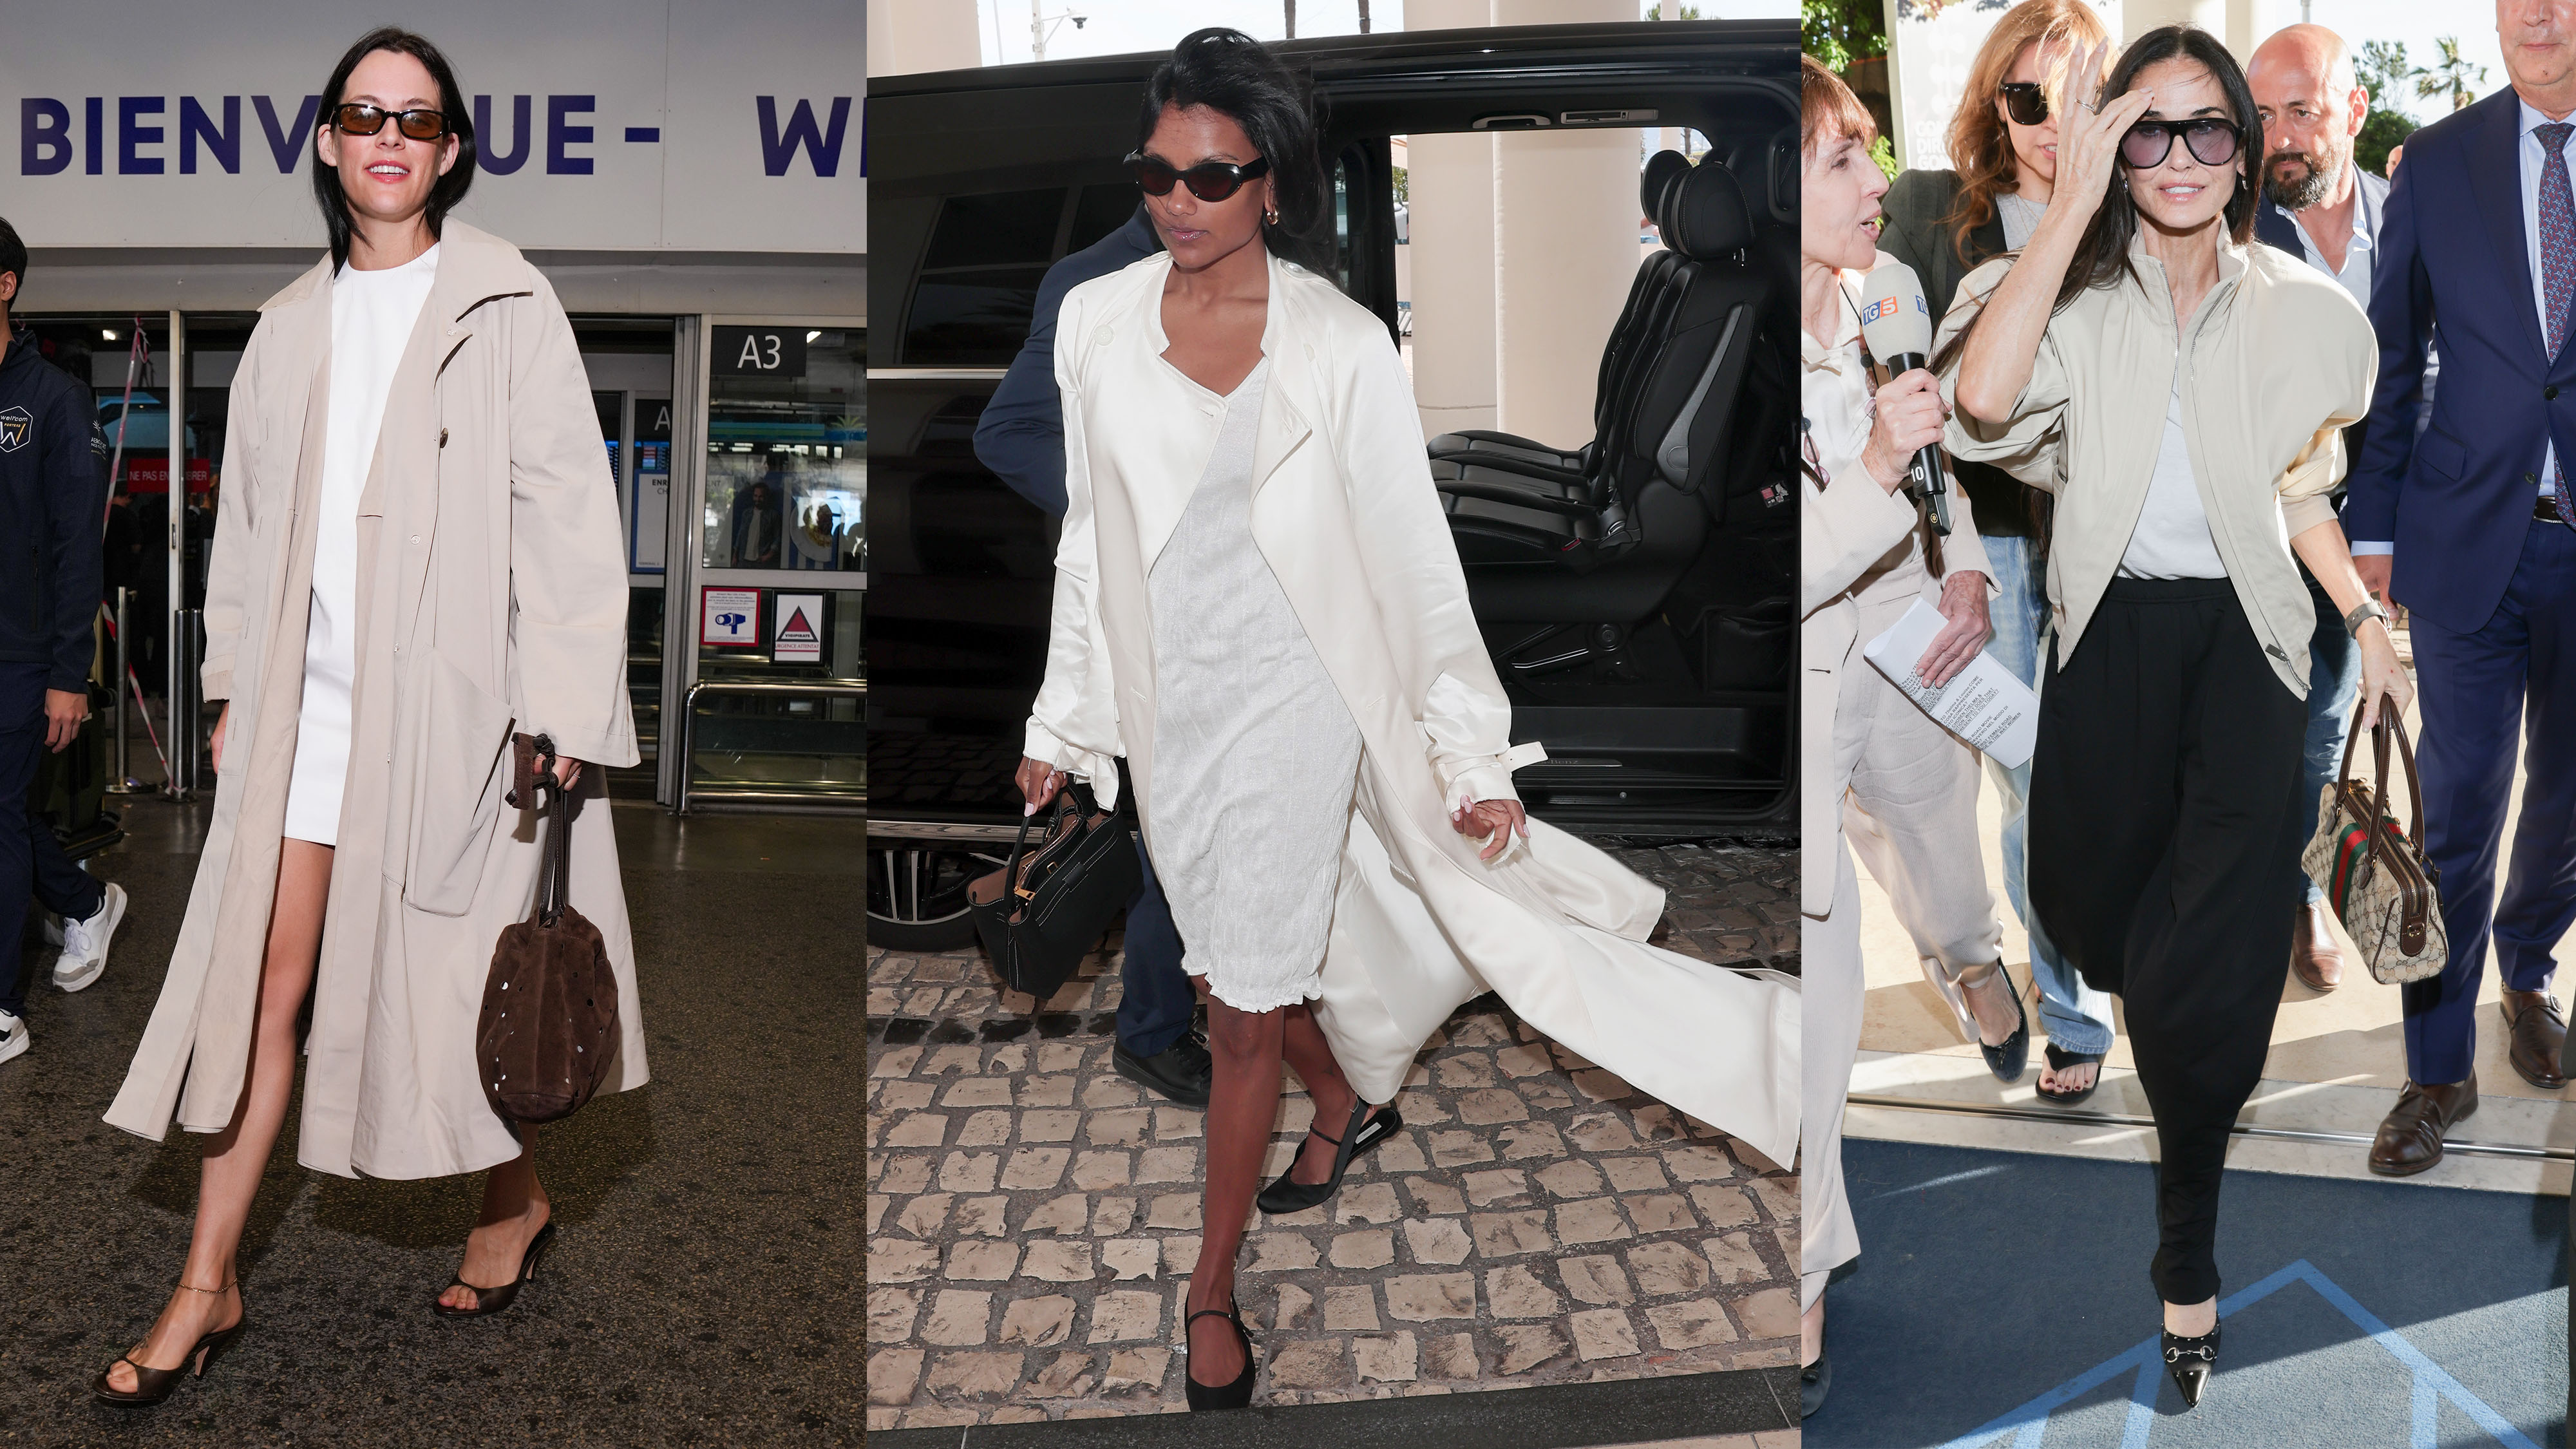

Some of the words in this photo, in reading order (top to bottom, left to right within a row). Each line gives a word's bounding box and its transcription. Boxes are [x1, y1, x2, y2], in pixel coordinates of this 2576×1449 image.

[756, 95, 867, 178] W
[1863, 296, 1897, 324] TG5
[737, 335, 781, 370] A3
[129, 471, 140, 481] NE
[142, 471, 158, 481] PAS
[1910, 466, 1924, 482] 10
